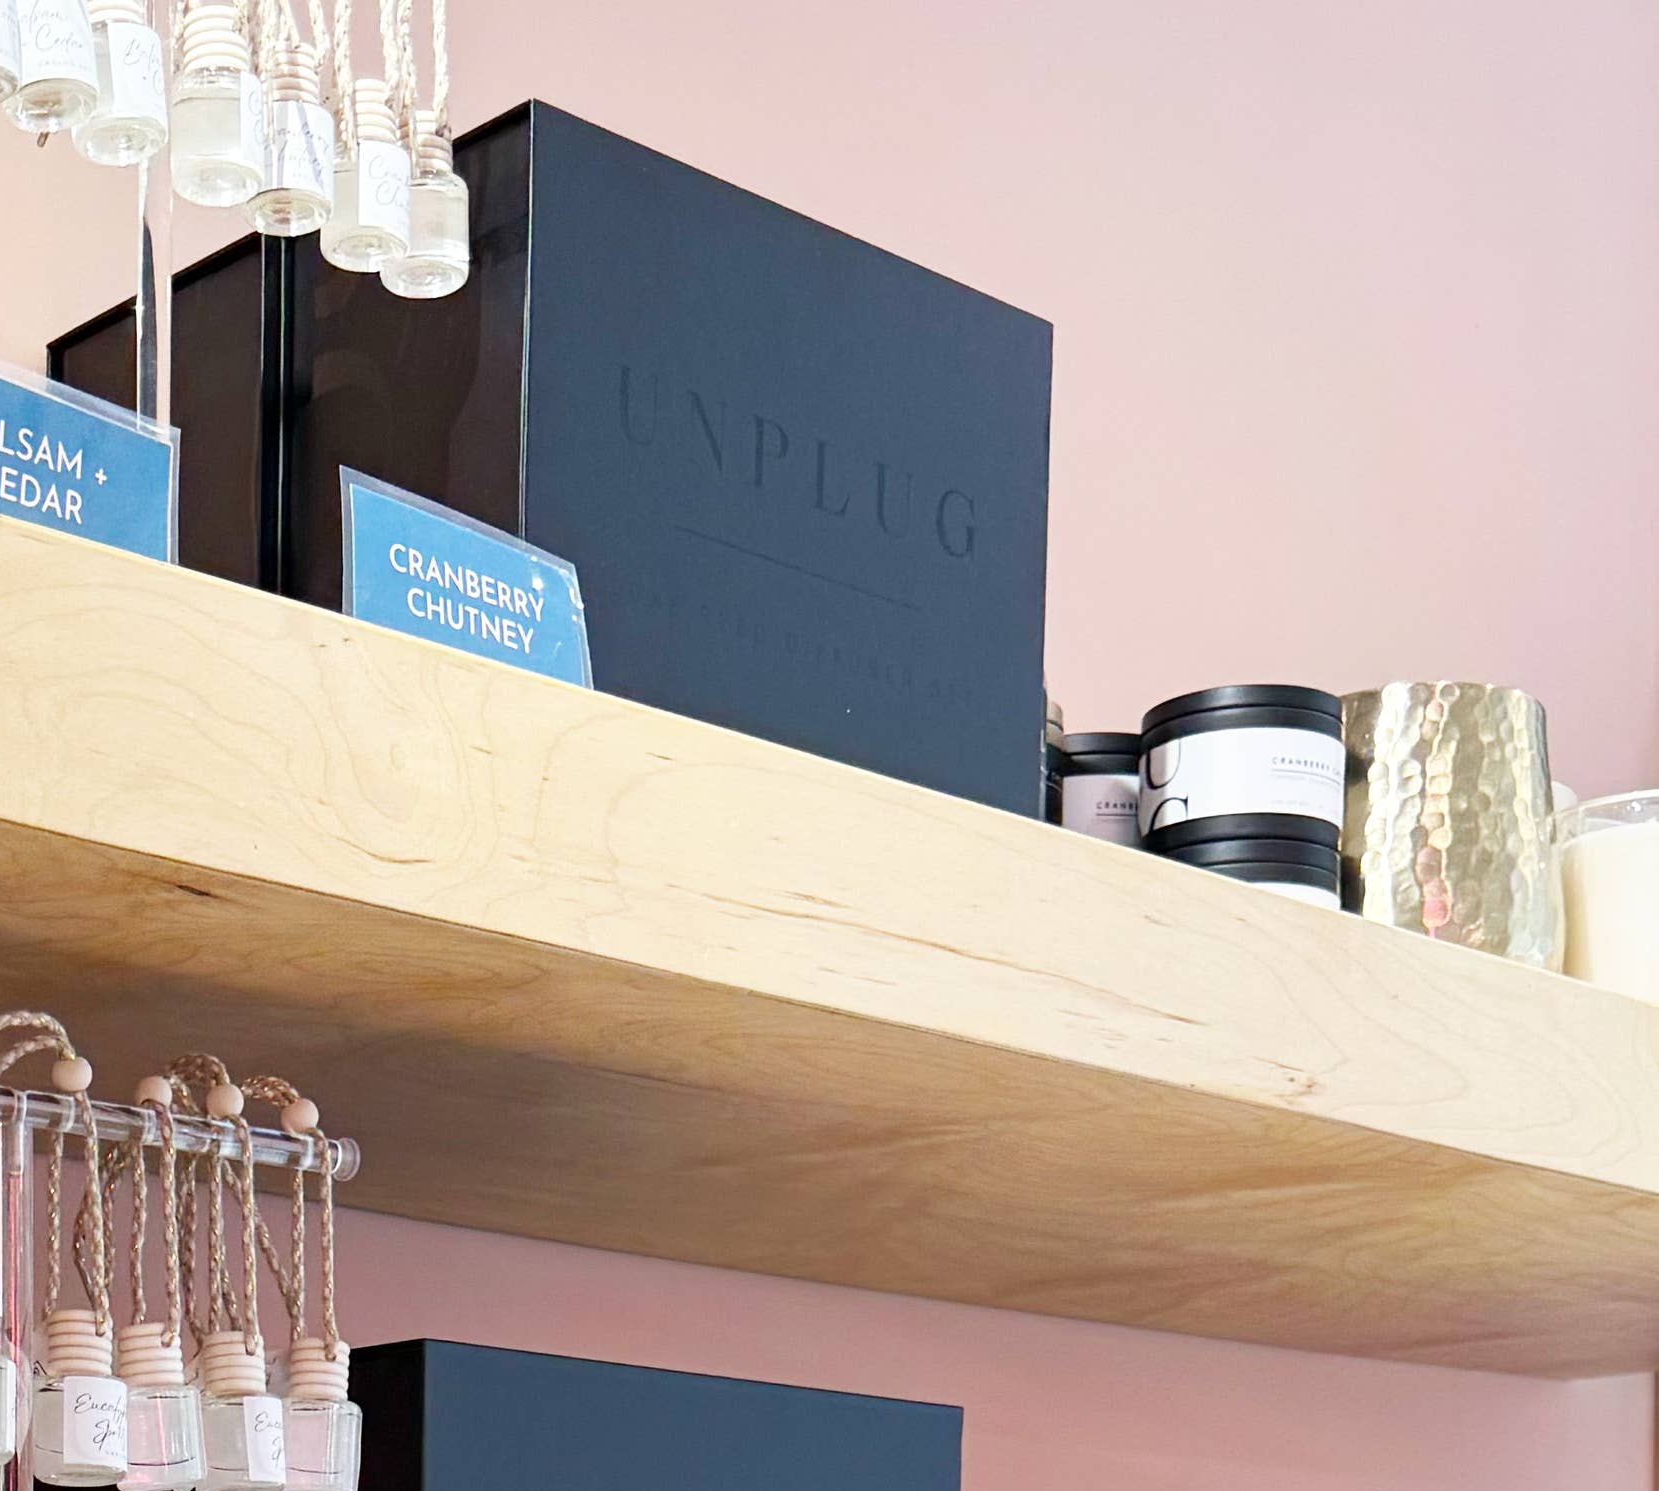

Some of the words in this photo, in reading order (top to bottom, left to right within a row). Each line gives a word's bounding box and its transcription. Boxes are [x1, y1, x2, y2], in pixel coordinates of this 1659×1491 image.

[619, 365, 977, 559] UNPLUG
[388, 543, 545, 622] CRANBERRY
[406, 587, 534, 654] CHUTNEY
[1095, 801, 1138, 810] CRANB
